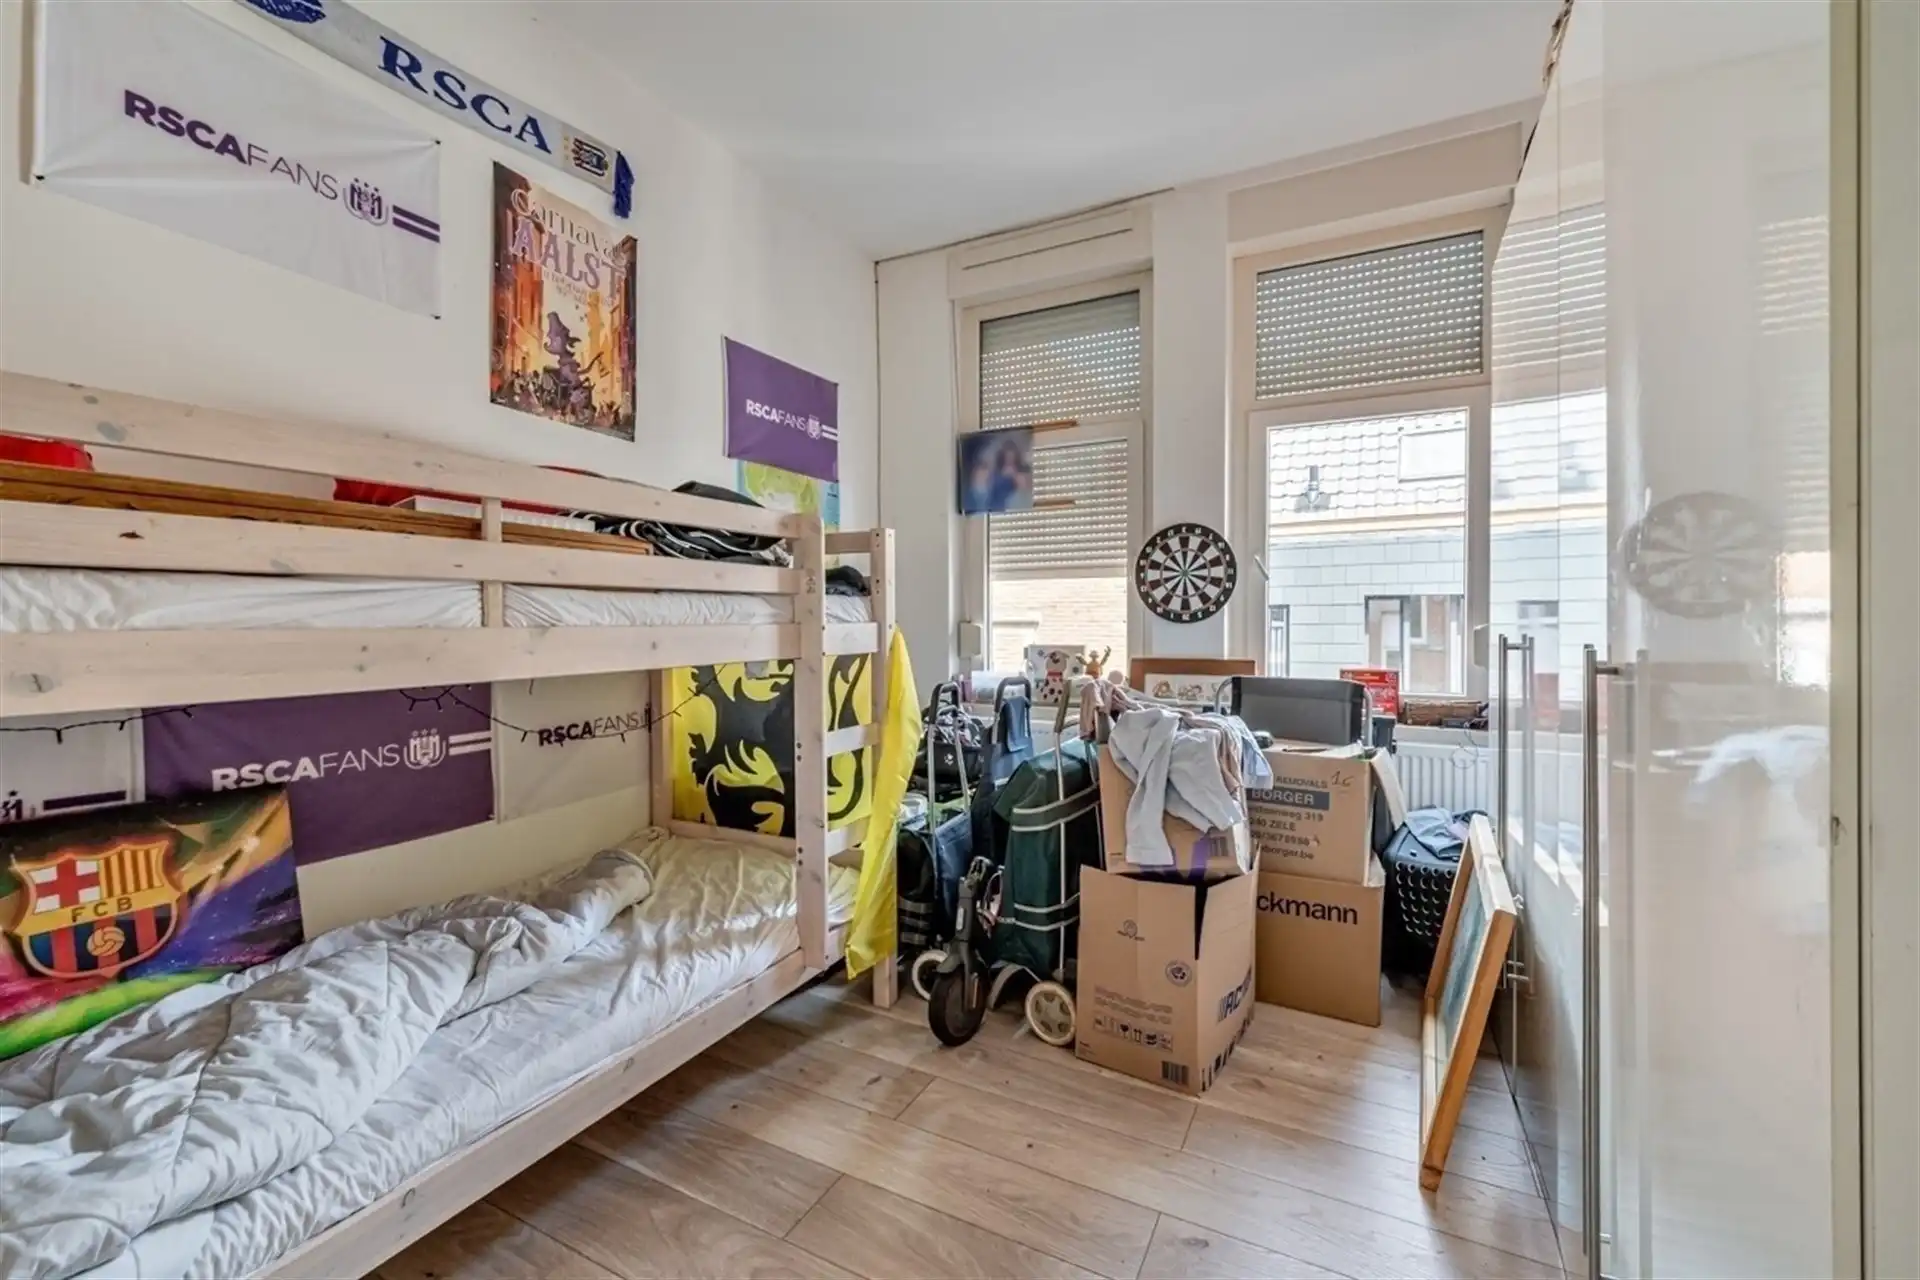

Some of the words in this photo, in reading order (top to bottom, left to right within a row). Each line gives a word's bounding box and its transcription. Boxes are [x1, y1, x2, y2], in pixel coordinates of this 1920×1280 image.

[376, 35, 553, 155] RSCA
[124, 88, 339, 201] RSCAFANS
[509, 214, 626, 300] AALST
[745, 398, 807, 432] RSCAFANS
[538, 711, 639, 748] RSCAFANS
[211, 743, 401, 793] RSCAFANS
[1275, 775, 1328, 789] REMOVALS
[1251, 788, 1315, 806] BORGER
[70, 896, 134, 923] FCB
[1256, 890, 1359, 926] ckmann
